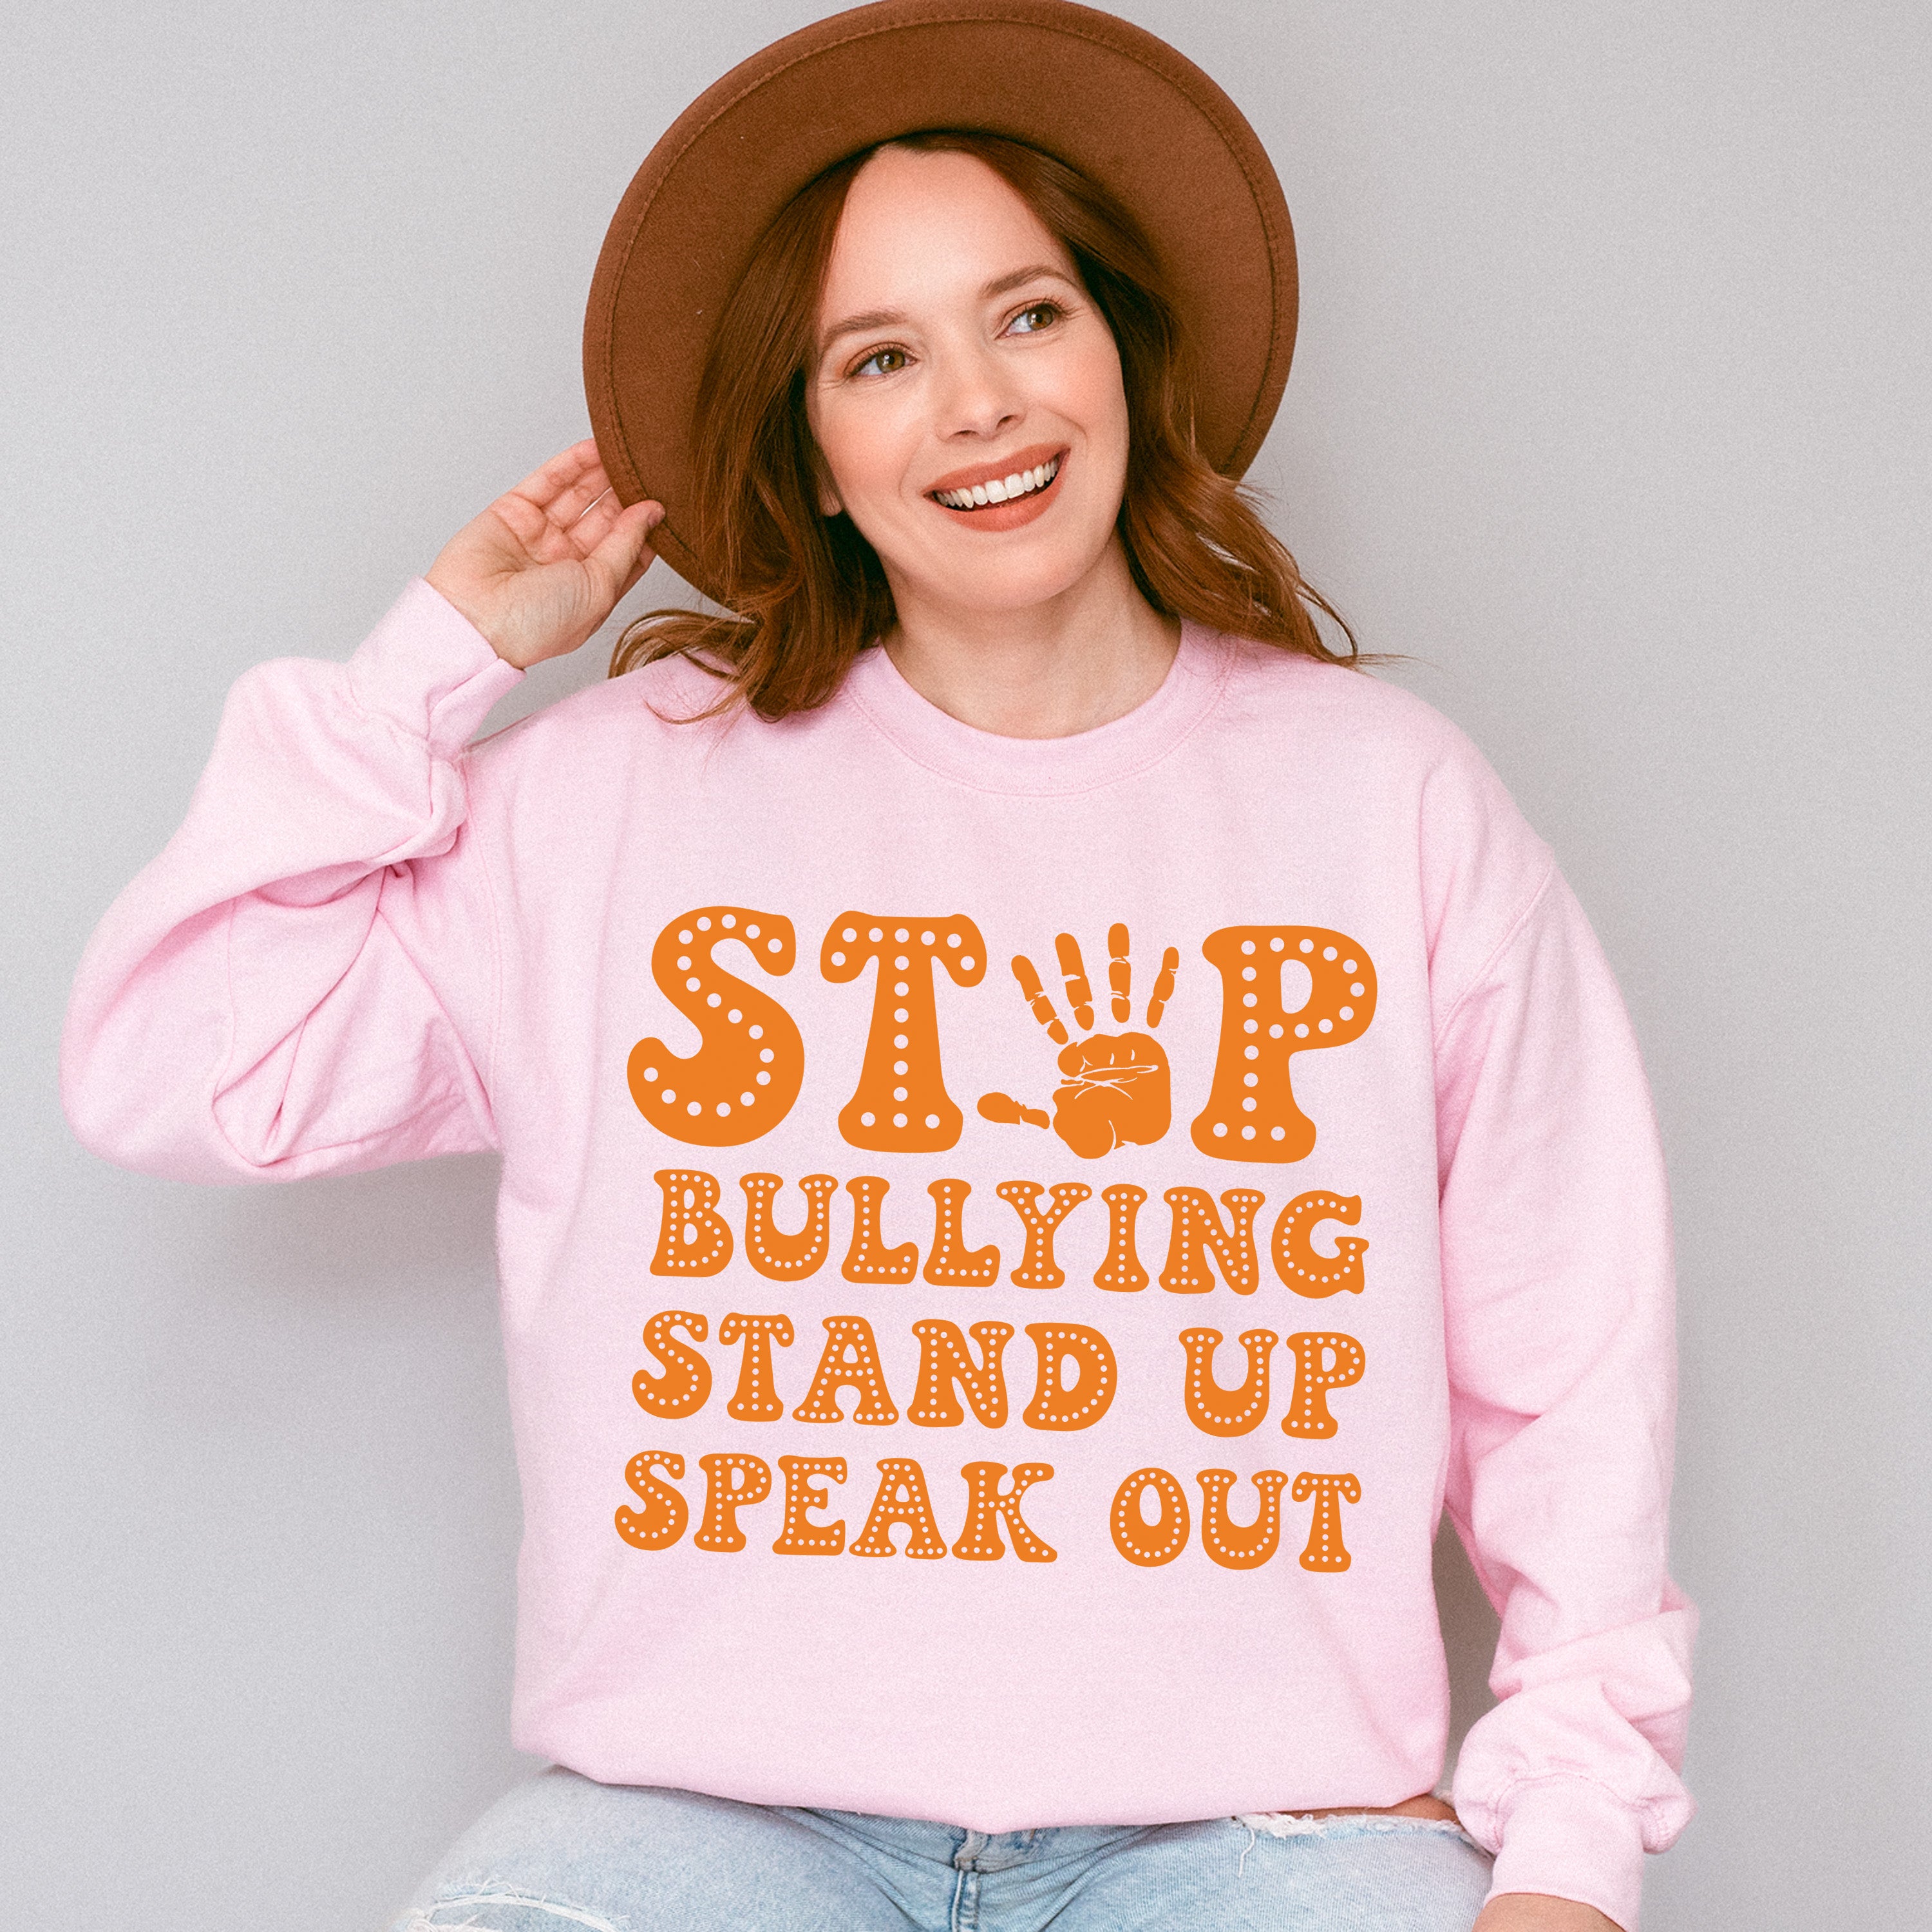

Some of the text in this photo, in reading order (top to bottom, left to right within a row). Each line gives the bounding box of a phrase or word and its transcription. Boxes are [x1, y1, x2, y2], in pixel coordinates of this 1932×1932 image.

[627, 906, 1378, 1164] STP
[650, 1170, 1370, 1299] BULLYING
[632, 1311, 1366, 1440] STAND UP
[615, 1450, 1361, 1573] SPEAK OUT
